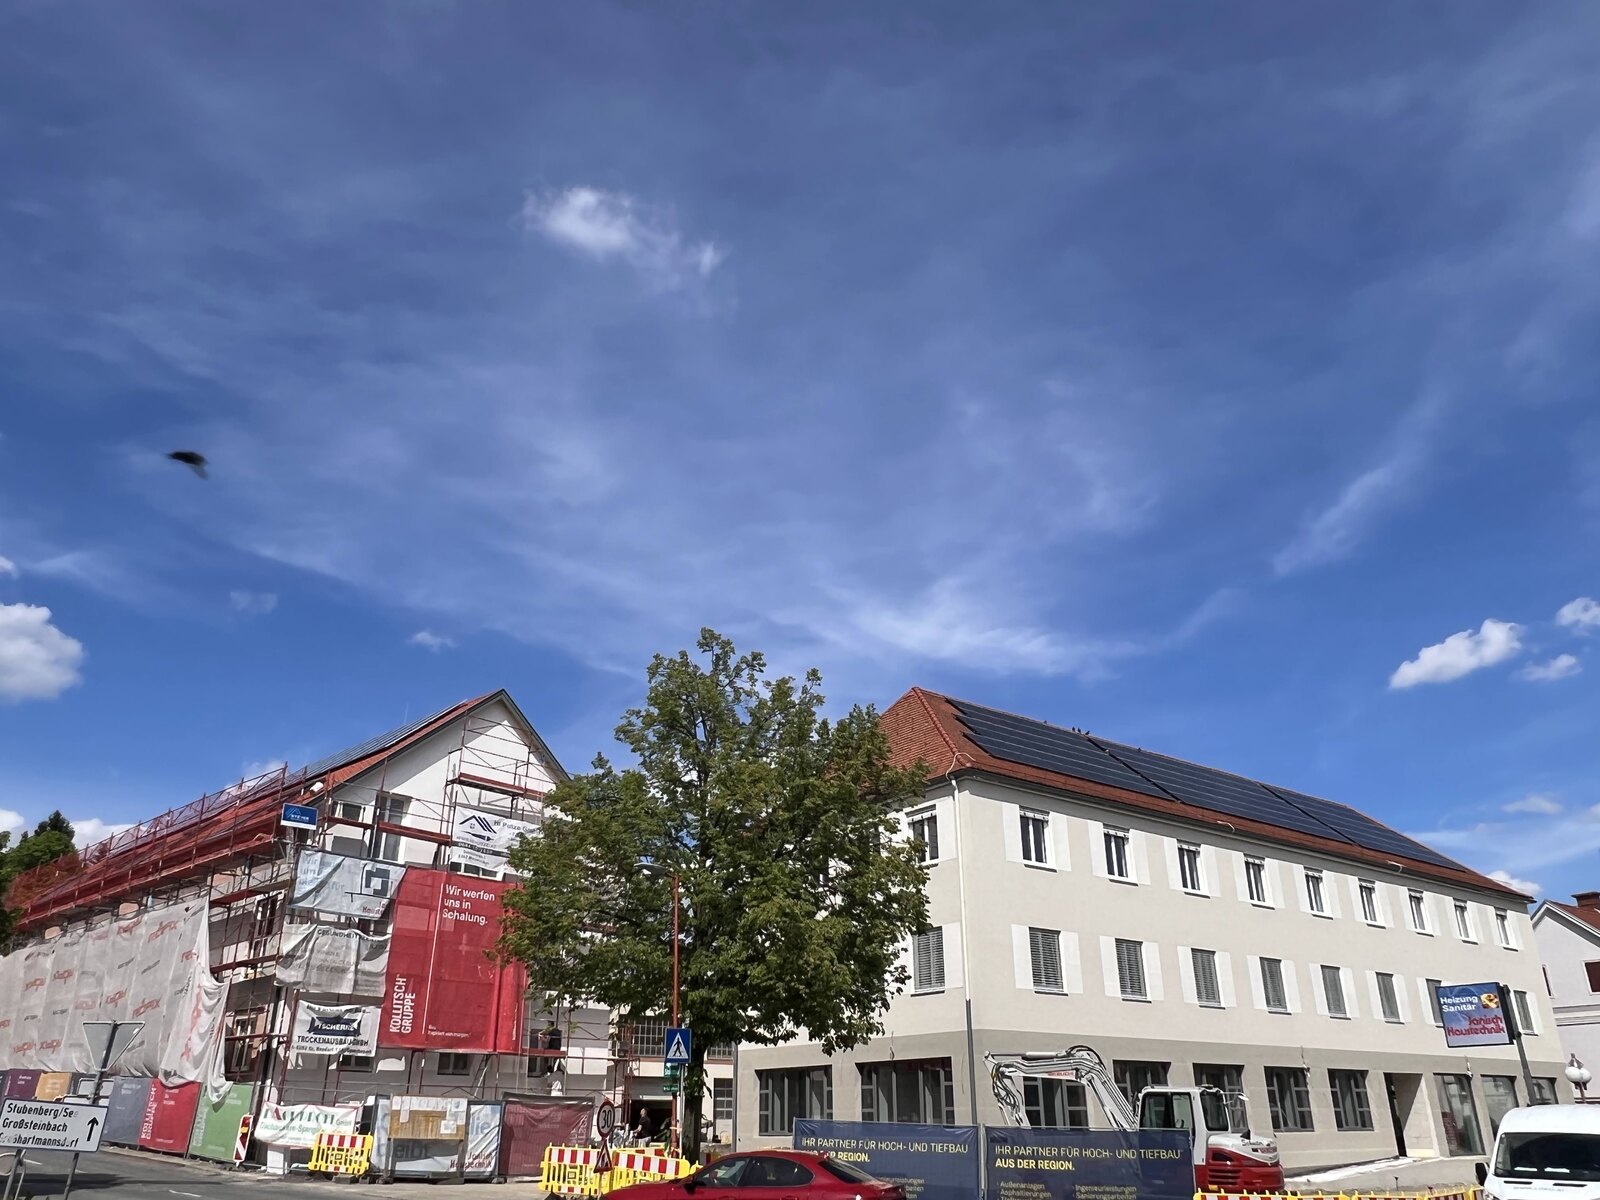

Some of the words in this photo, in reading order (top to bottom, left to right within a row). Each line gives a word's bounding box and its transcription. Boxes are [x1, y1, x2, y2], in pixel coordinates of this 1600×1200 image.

[445, 884, 461, 896] Wir
[463, 890, 495, 901] werfen
[444, 898, 460, 908] uns
[462, 899, 471, 909] in
[442, 908, 488, 926] Schalung.
[389, 977, 407, 1033] KOLLITSCH
[1440, 995, 1479, 1004] Heizung
[401, 992, 415, 1034] GRUPPE
[1442, 1004, 1477, 1012] Sanitär
[1447, 1025, 1506, 1036] Haustechnik
[7, 1102, 79, 1119] Stubenberg/See
[2, 1117, 68, 1132] Großsteinbach
[601, 1109, 612, 1129] 30
[802, 1137, 816, 1147] IHR
[817, 1138, 857, 1149] PARTNER
[858, 1139, 876, 1150] FÜR
[878, 1141, 907, 1151] HOCH-
[908, 1142, 928, 1152] UND
[930, 1143, 968, 1154] TIEFBAU
[995, 1145, 1011, 1155] IHR
[1013, 1145, 1058, 1157] PARTNER
[1060, 1146, 1080, 1158] FÜR
[1082, 1148, 1113, 1158] HOCH-
[1115, 1149, 1137, 1159] UND
[1139, 1149, 1181, 1159] TIEFBAU
[838, 1152, 870, 1162] REGION.
[995, 1158, 1015, 1168] AUS
[1017, 1158, 1036, 1169] DER
[1038, 1160, 1075, 1171] REGION.
